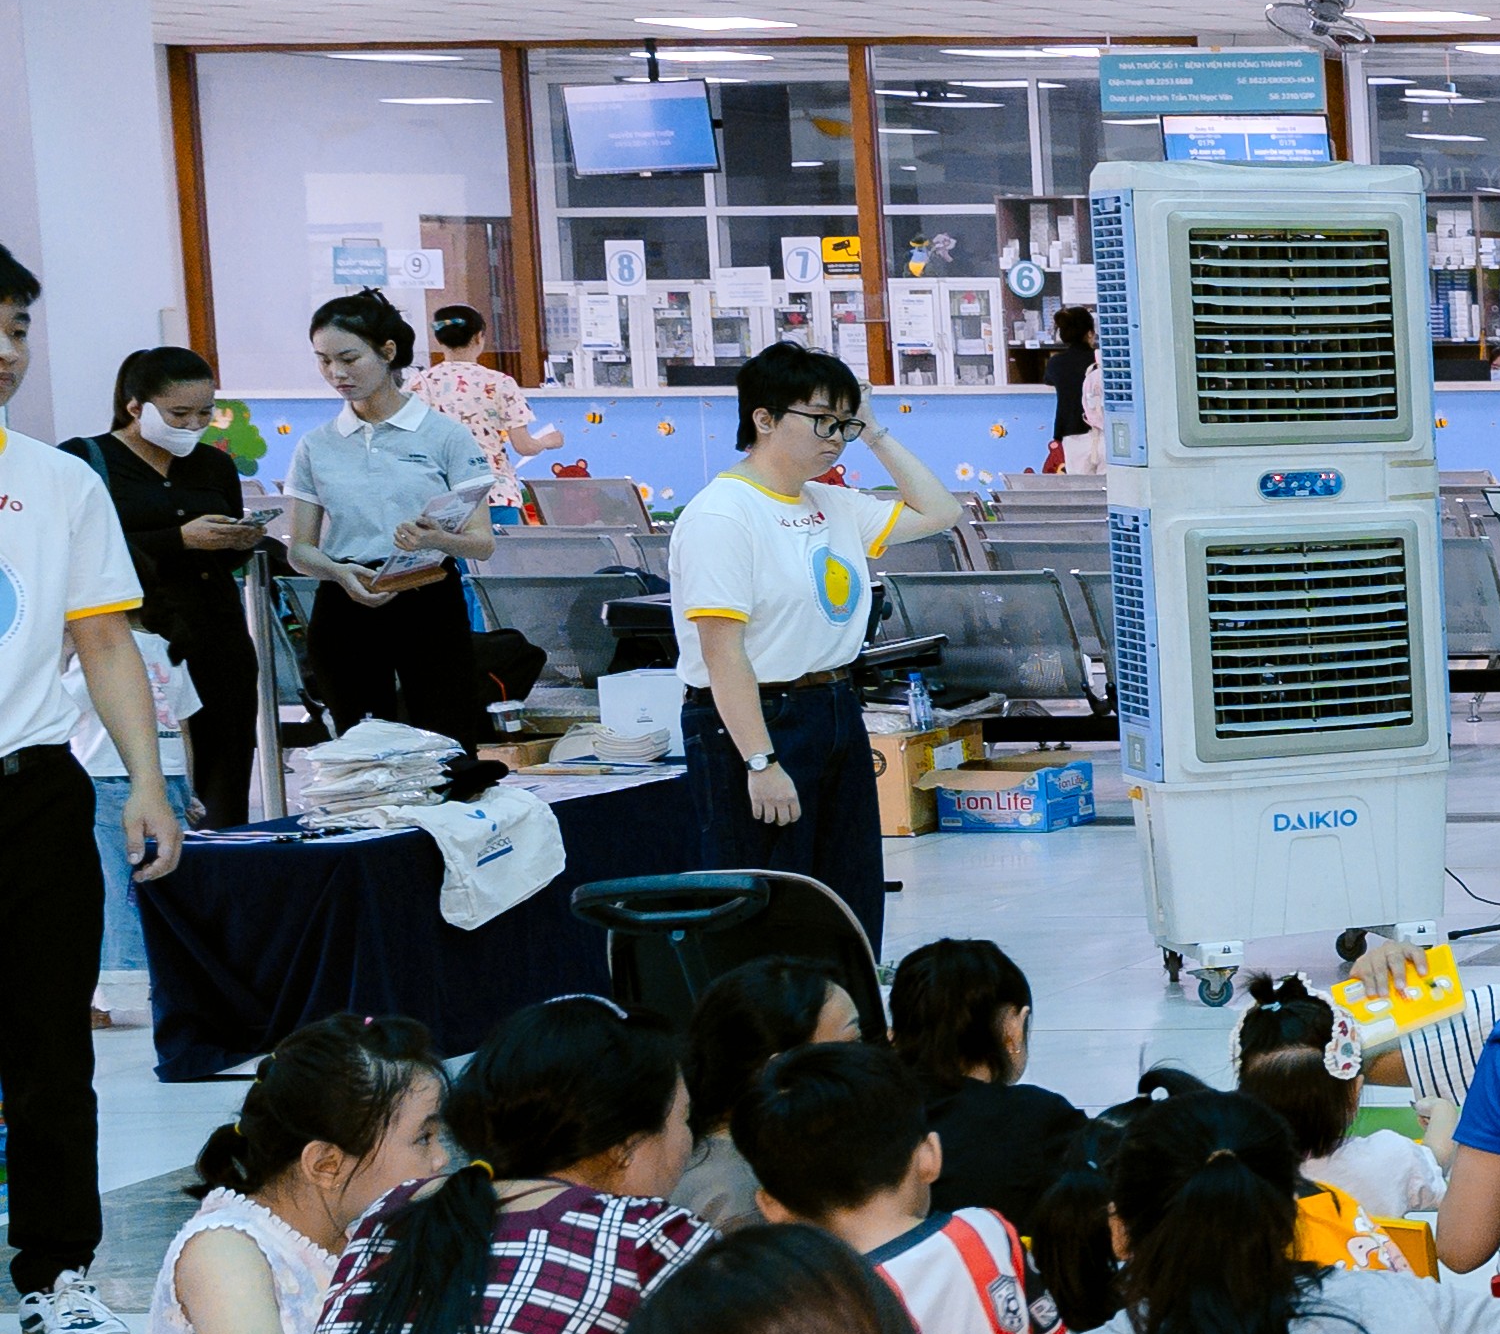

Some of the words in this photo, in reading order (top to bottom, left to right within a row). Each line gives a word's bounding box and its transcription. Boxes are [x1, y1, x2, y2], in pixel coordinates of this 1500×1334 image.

[412, 257, 422, 273] 9
[618, 254, 635, 282] 8
[795, 251, 810, 279] 7
[1016, 267, 1035, 291] 6
[996, 792, 1032, 811] Life
[1273, 809, 1358, 832] DAIKIO
